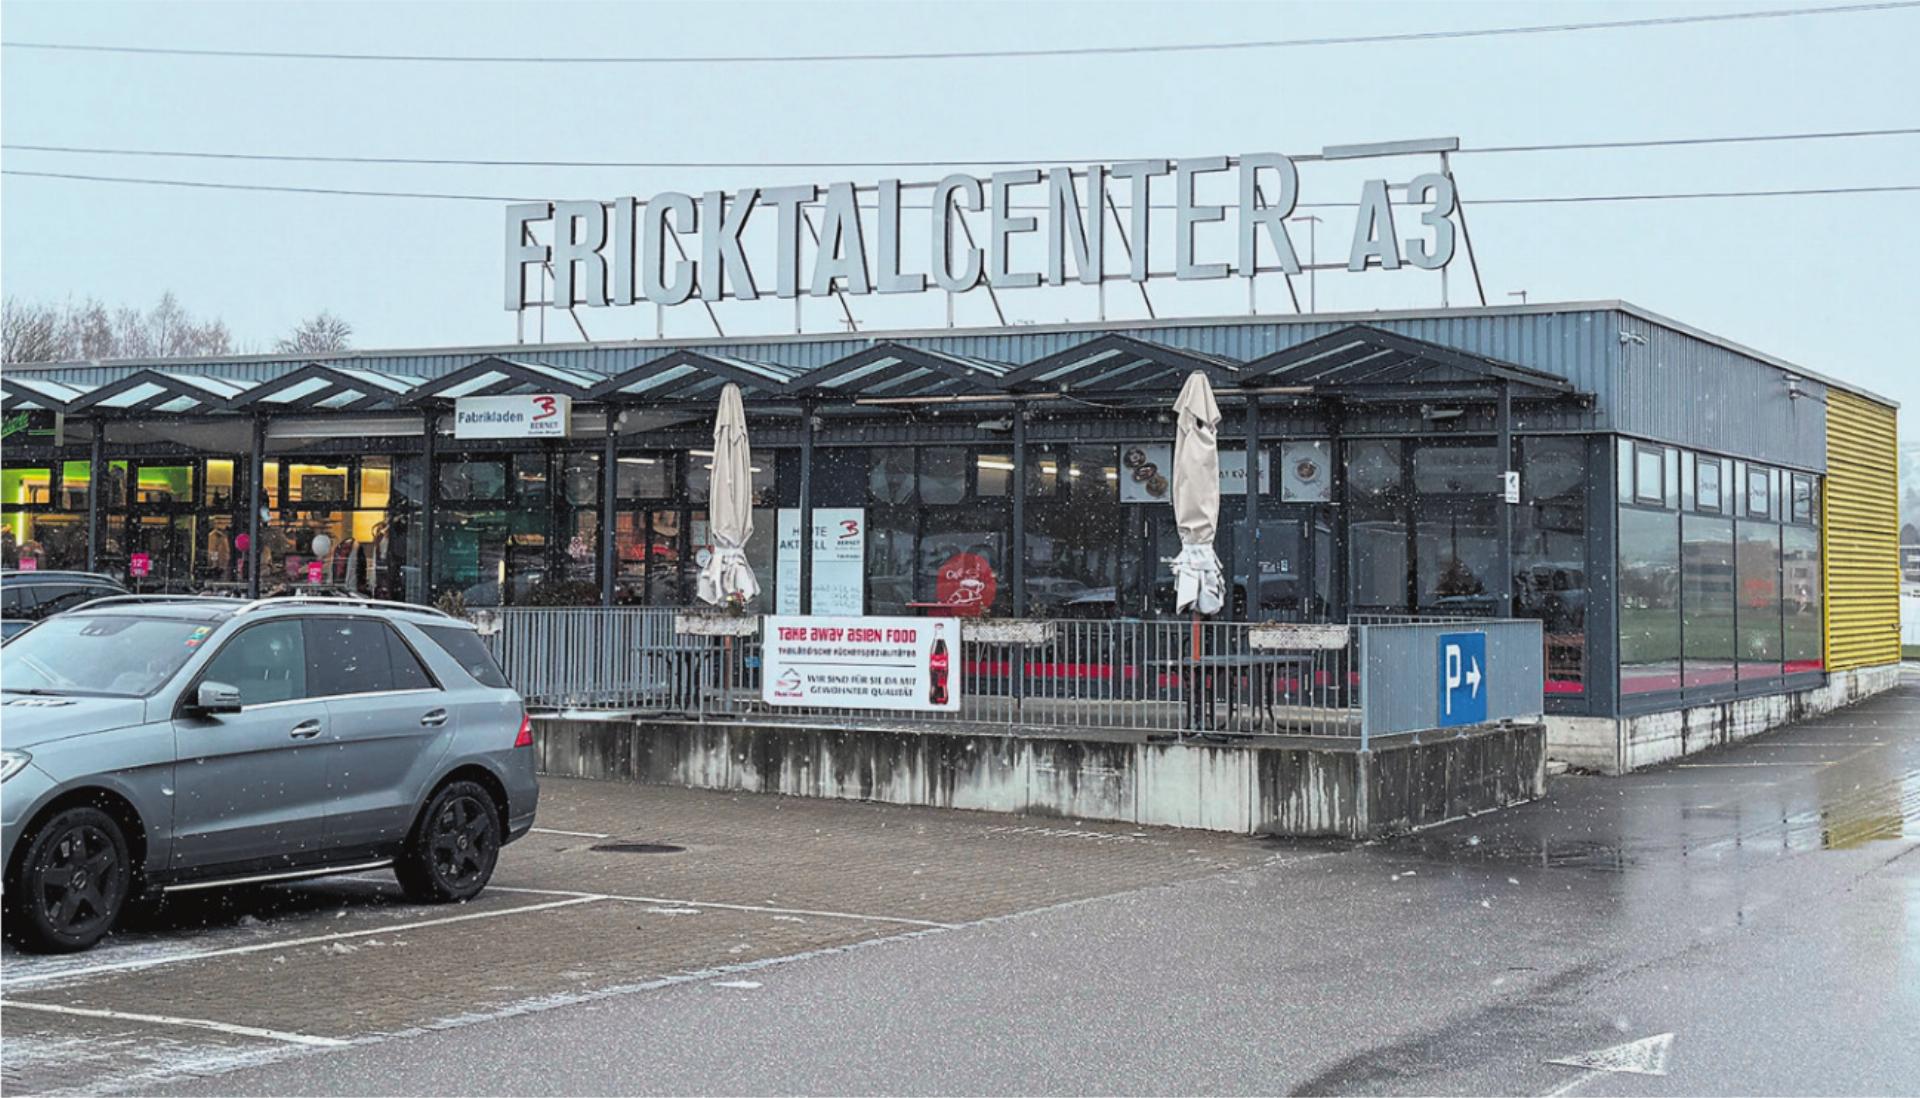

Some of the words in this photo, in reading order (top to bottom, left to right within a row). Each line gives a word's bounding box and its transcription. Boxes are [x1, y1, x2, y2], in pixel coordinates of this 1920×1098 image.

[504, 153, 1302, 311] FRICKTALCENTER
[1348, 173, 1455, 273] A3
[458, 410, 524, 424] Fabrikladen
[792, 526, 828, 537] HTE
[780, 540, 828, 550] AKTLL
[887, 629, 916, 643] FOOD
[807, 674, 826, 683] WIR
[828, 675, 849, 684] SIND
[851, 674, 868, 684] FÜR
[870, 676, 881, 685] SIE
[884, 677, 897, 685] DA
[900, 677, 916, 686] MIT
[1446, 644, 1461, 715] P
[810, 686, 868, 695] GEWOHNTER
[871, 686, 912, 697] QUALITÄT
